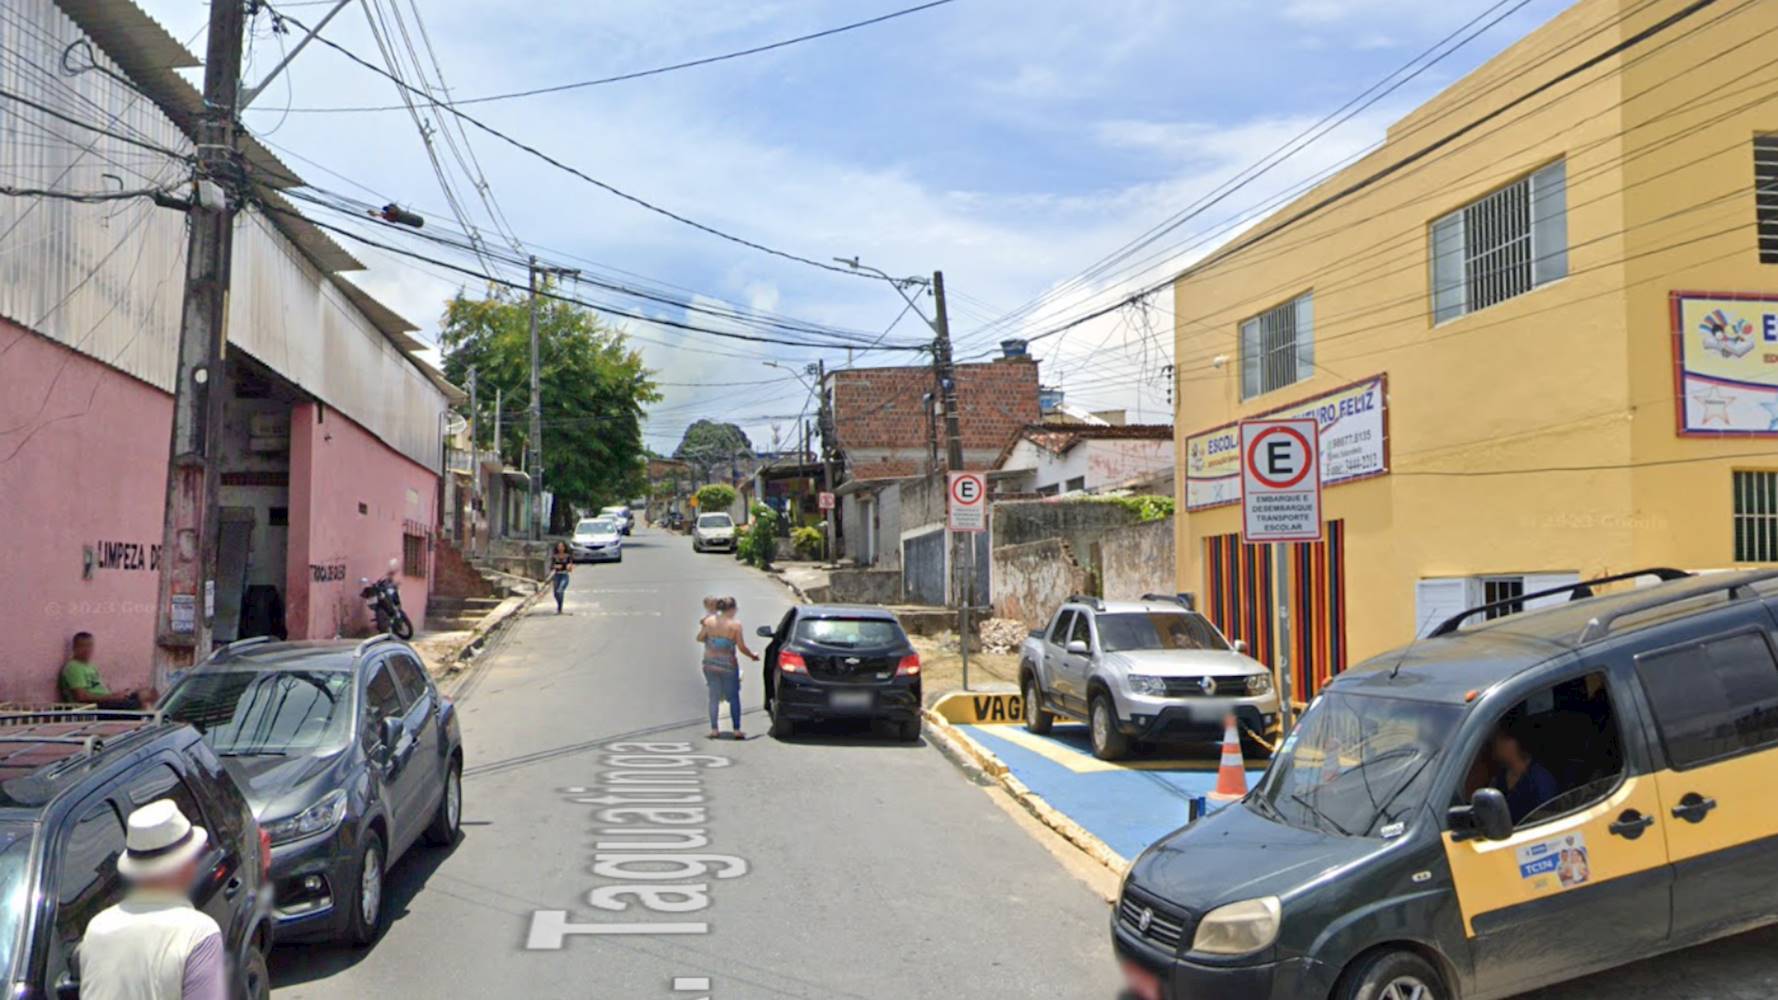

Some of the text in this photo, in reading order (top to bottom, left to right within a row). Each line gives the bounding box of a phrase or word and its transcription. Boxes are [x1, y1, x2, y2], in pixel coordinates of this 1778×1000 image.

[1339, 391, 1374, 418] FELIZ
[1267, 441, 1293, 474] E
[962, 481, 973, 497] E
[1256, 494, 1308, 503] EMBARQUE E
[1252, 504, 1312, 513] DESEMBARQUE
[1256, 514, 1309, 522] TRANSPORTE
[1264, 523, 1303, 531] ESCOLAR
[98, 540, 145, 571] LIMPEZA
[974, 696, 1026, 721] VAG
